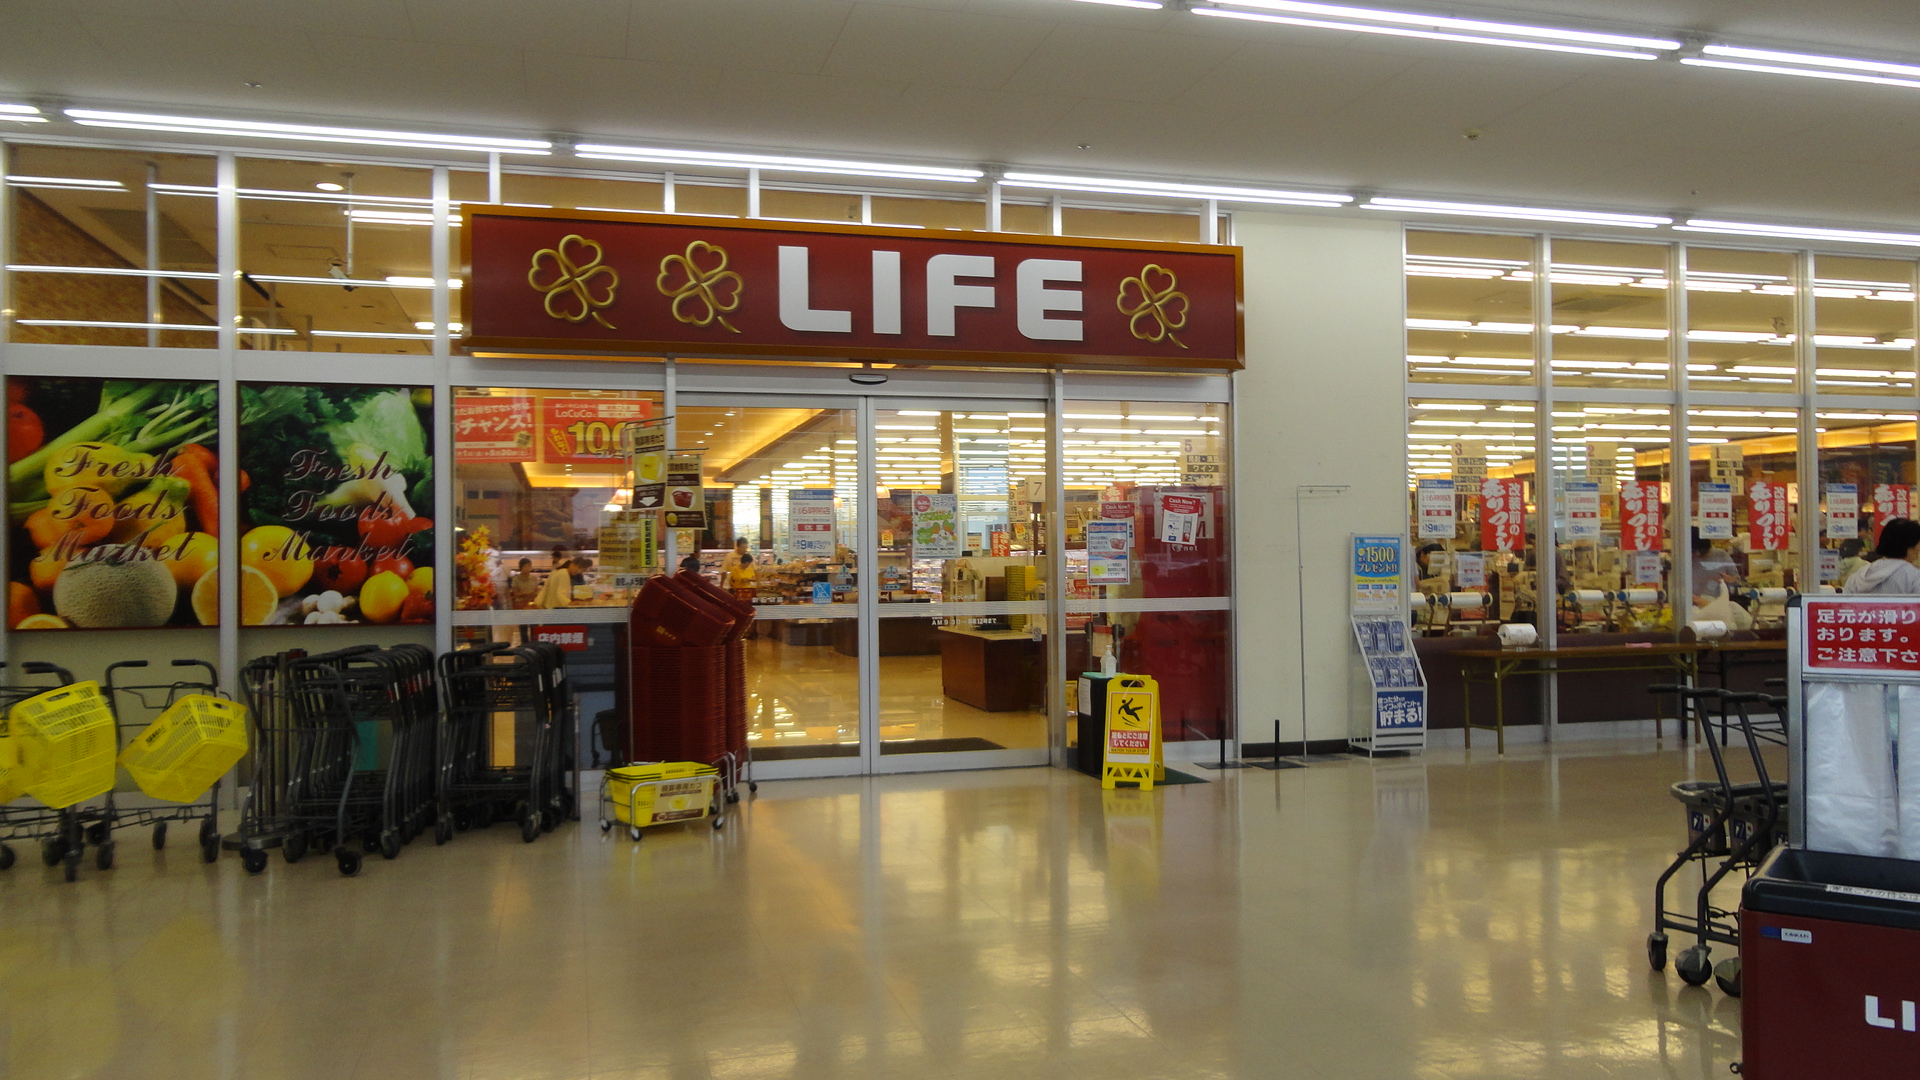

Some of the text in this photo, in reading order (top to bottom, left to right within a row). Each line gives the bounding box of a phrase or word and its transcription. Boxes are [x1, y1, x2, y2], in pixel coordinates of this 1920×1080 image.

[778, 245, 1084, 342] LIFE
[1184, 438, 1193, 453] 5
[1455, 443, 1463, 456] 3
[1587, 444, 1595, 457] 2
[1715, 447, 1721, 459] 1
[54, 443, 186, 480] Fresh
[283, 447, 399, 482] Fresh
[1033, 481, 1043, 496] 7
[52, 486, 188, 522] Foods
[282, 489, 405, 524] Foods
[1481, 478, 1515, 551] 売りつくし
[1508, 482, 1522, 536] 改装前の
[1621, 480, 1653, 551] 売りつくし
[1749, 481, 1781, 551] 売りつくし
[1896, 488, 1908, 519] 改装
[35, 529, 198, 564] Market
[262, 531, 416, 565] Market
[1366, 546, 1395, 563] 1500
[1816, 608, 1917, 625] 足元が滑り
[537, 631, 584, 645] 店内禁煙
[1816, 627, 1909, 644] おります。
[1816, 646, 1919, 664] ご注意下さ
[1380, 706, 1423, 727] 貯まる!
[1113, 740, 1146, 748] してください
